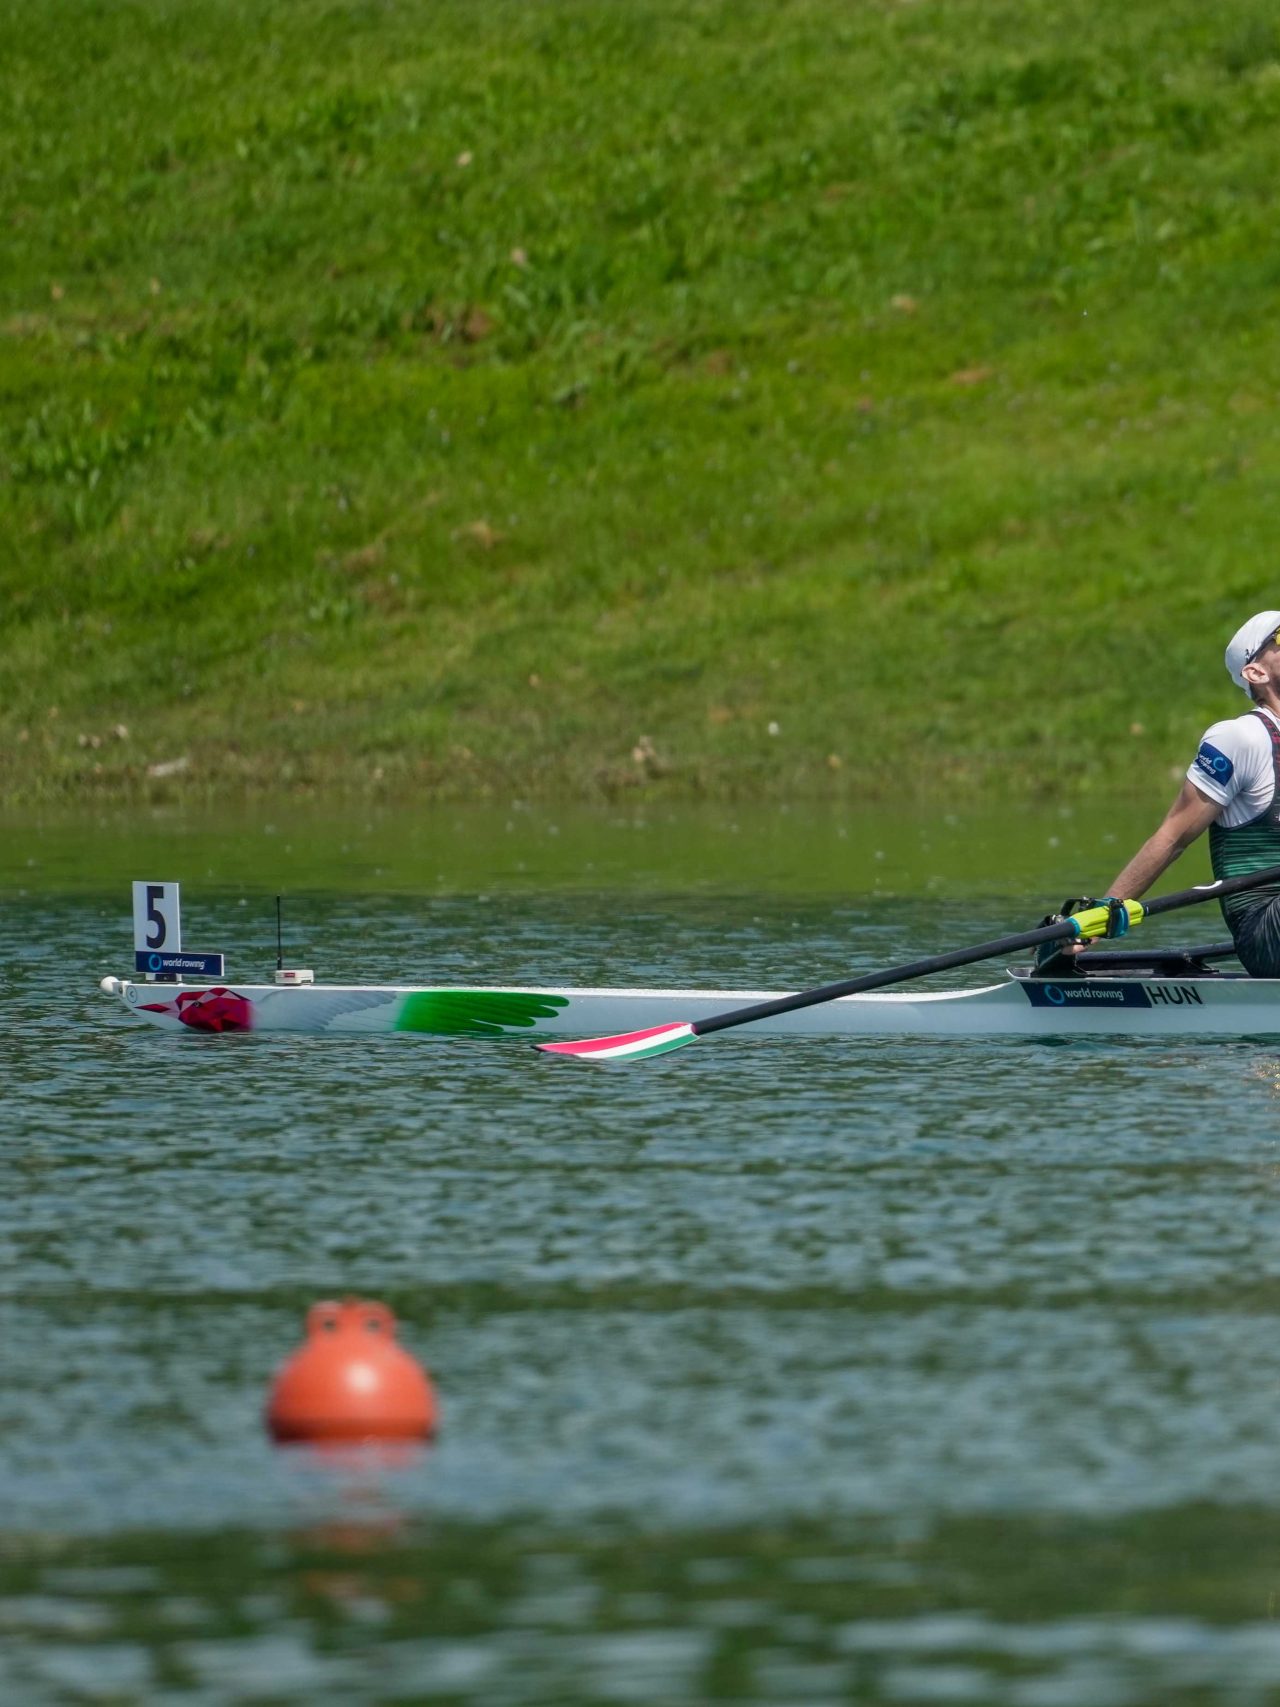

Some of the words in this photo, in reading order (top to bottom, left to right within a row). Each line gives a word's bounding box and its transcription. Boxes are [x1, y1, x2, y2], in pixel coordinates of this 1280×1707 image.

[146, 885, 166, 949] 5
[162, 958, 182, 967] world
[182, 960, 205, 970] rowing
[1064, 987, 1091, 998] world
[1091, 990, 1124, 1001] rowing
[1147, 986, 1203, 1005] HUN
